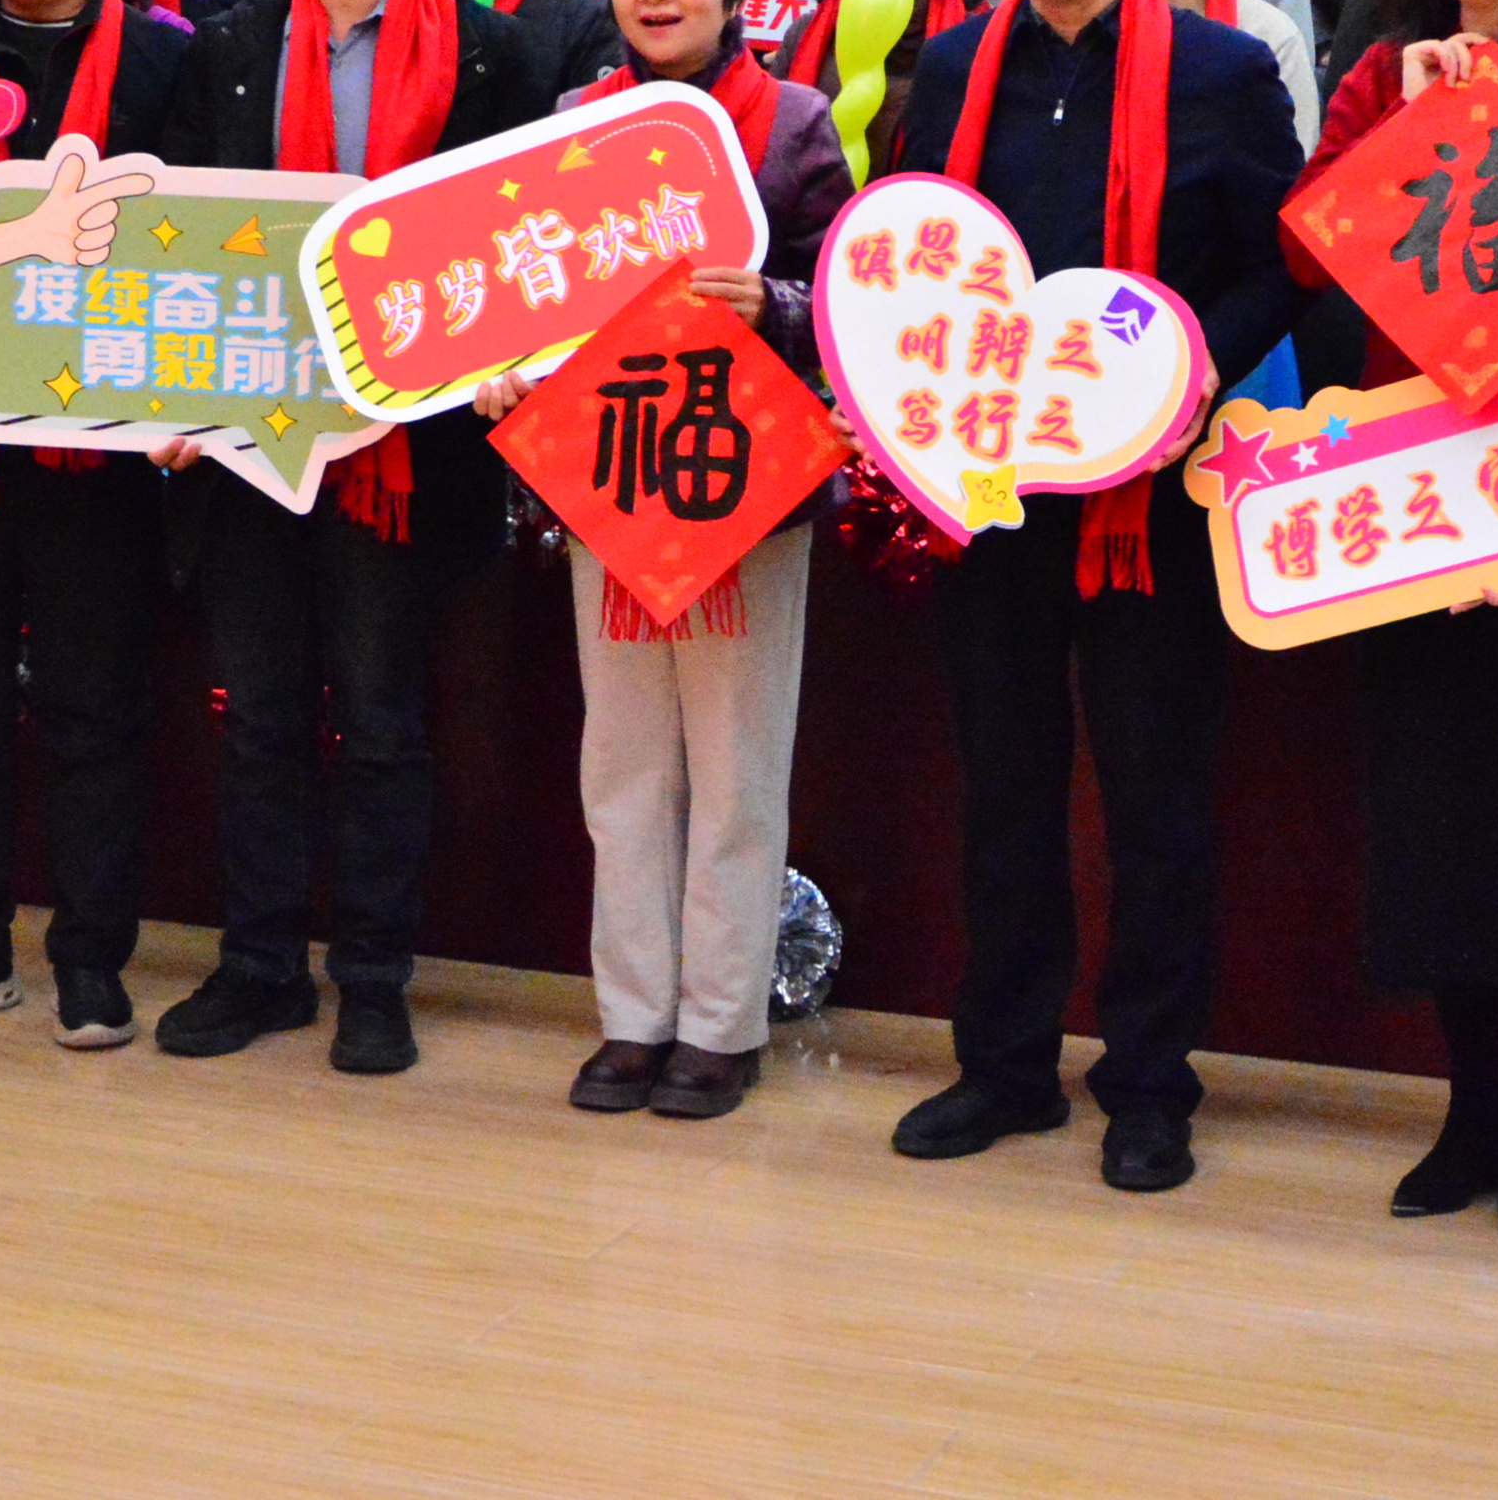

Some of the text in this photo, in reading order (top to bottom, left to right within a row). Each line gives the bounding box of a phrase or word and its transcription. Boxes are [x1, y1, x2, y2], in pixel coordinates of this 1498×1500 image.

[13, 261, 291, 332] 接续奋斗
[374, 183, 707, 359] 岁岁皆欢愉
[846, 216, 1030, 305] 慎思之
[898, 309, 1103, 383] 明辨之
[591, 345, 755, 524] 福
[895, 388, 1083, 463] 笃行之
